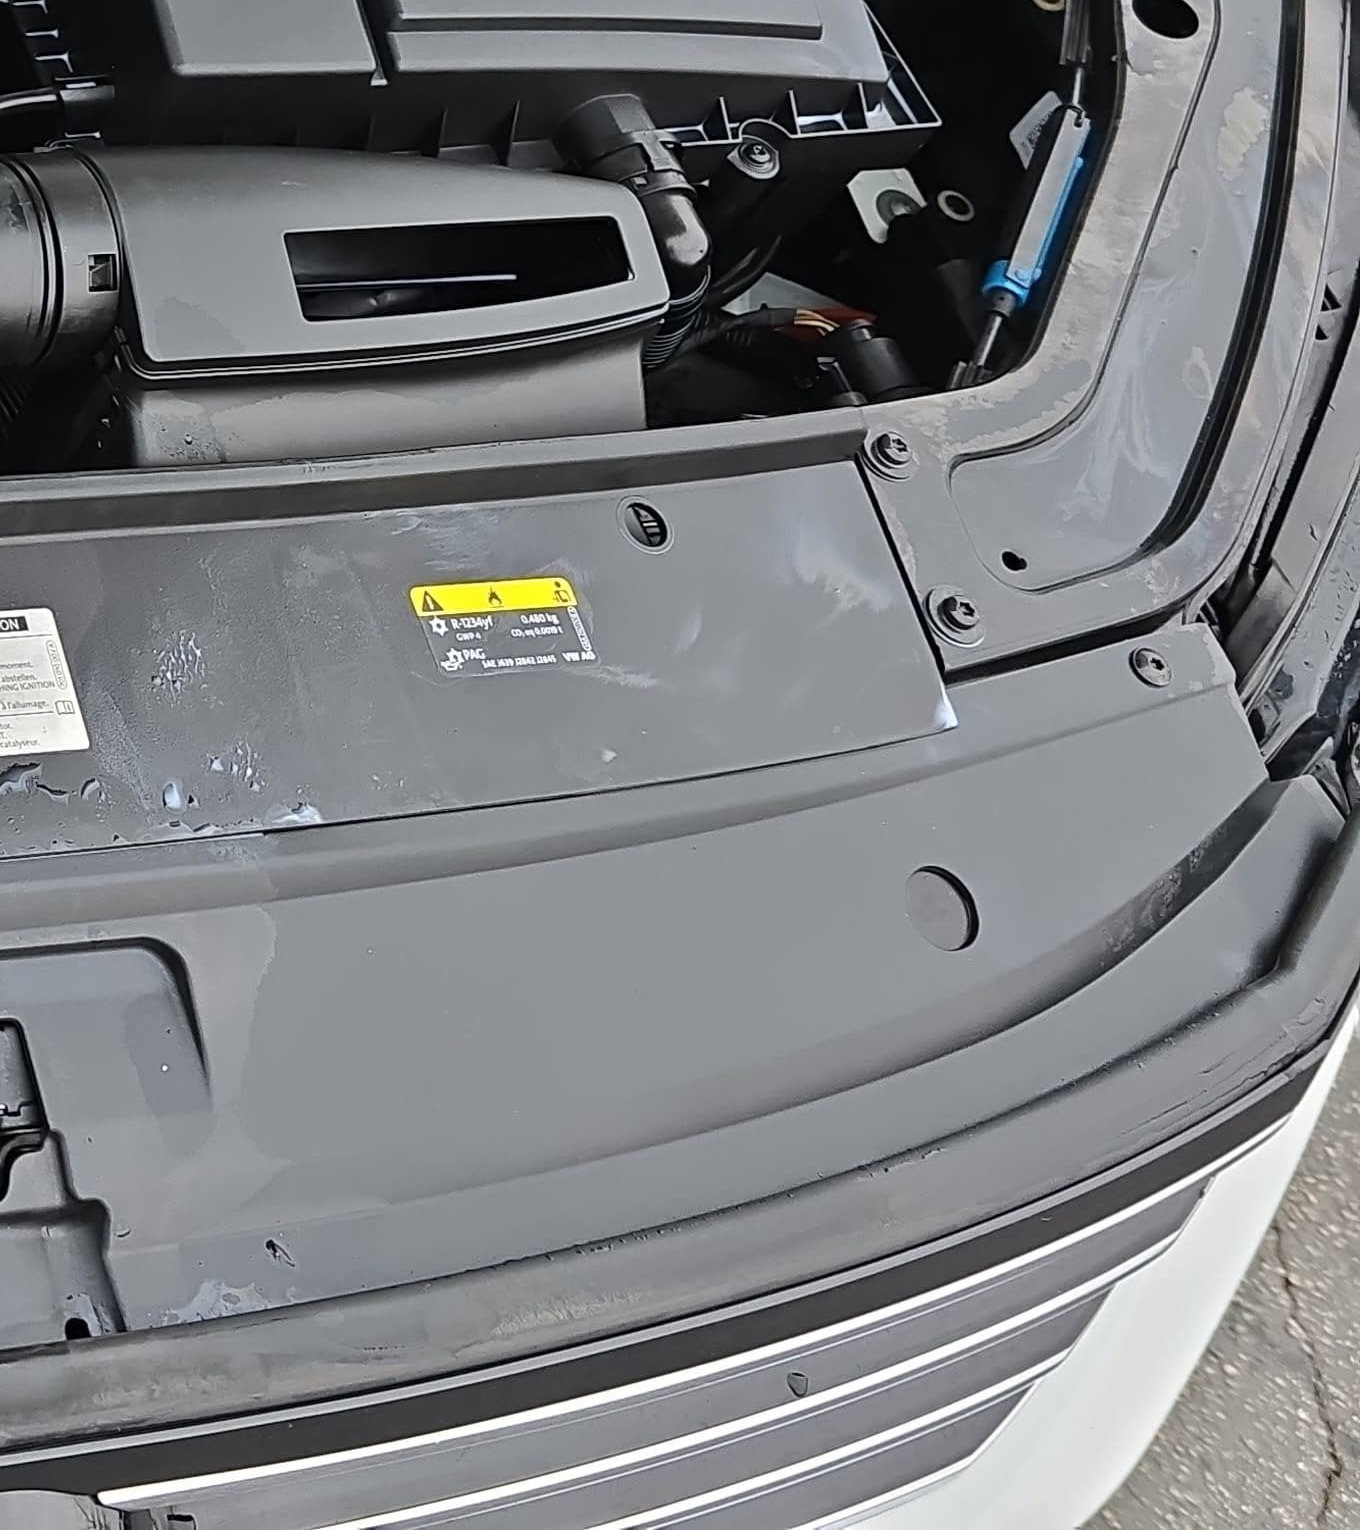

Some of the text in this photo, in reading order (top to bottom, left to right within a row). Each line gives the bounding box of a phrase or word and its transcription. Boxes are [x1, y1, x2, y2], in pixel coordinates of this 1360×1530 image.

[450, 615, 495, 632] R-1234yf
[462, 648, 486, 660] PAG
[20, 681, 55, 689] IGNITION
